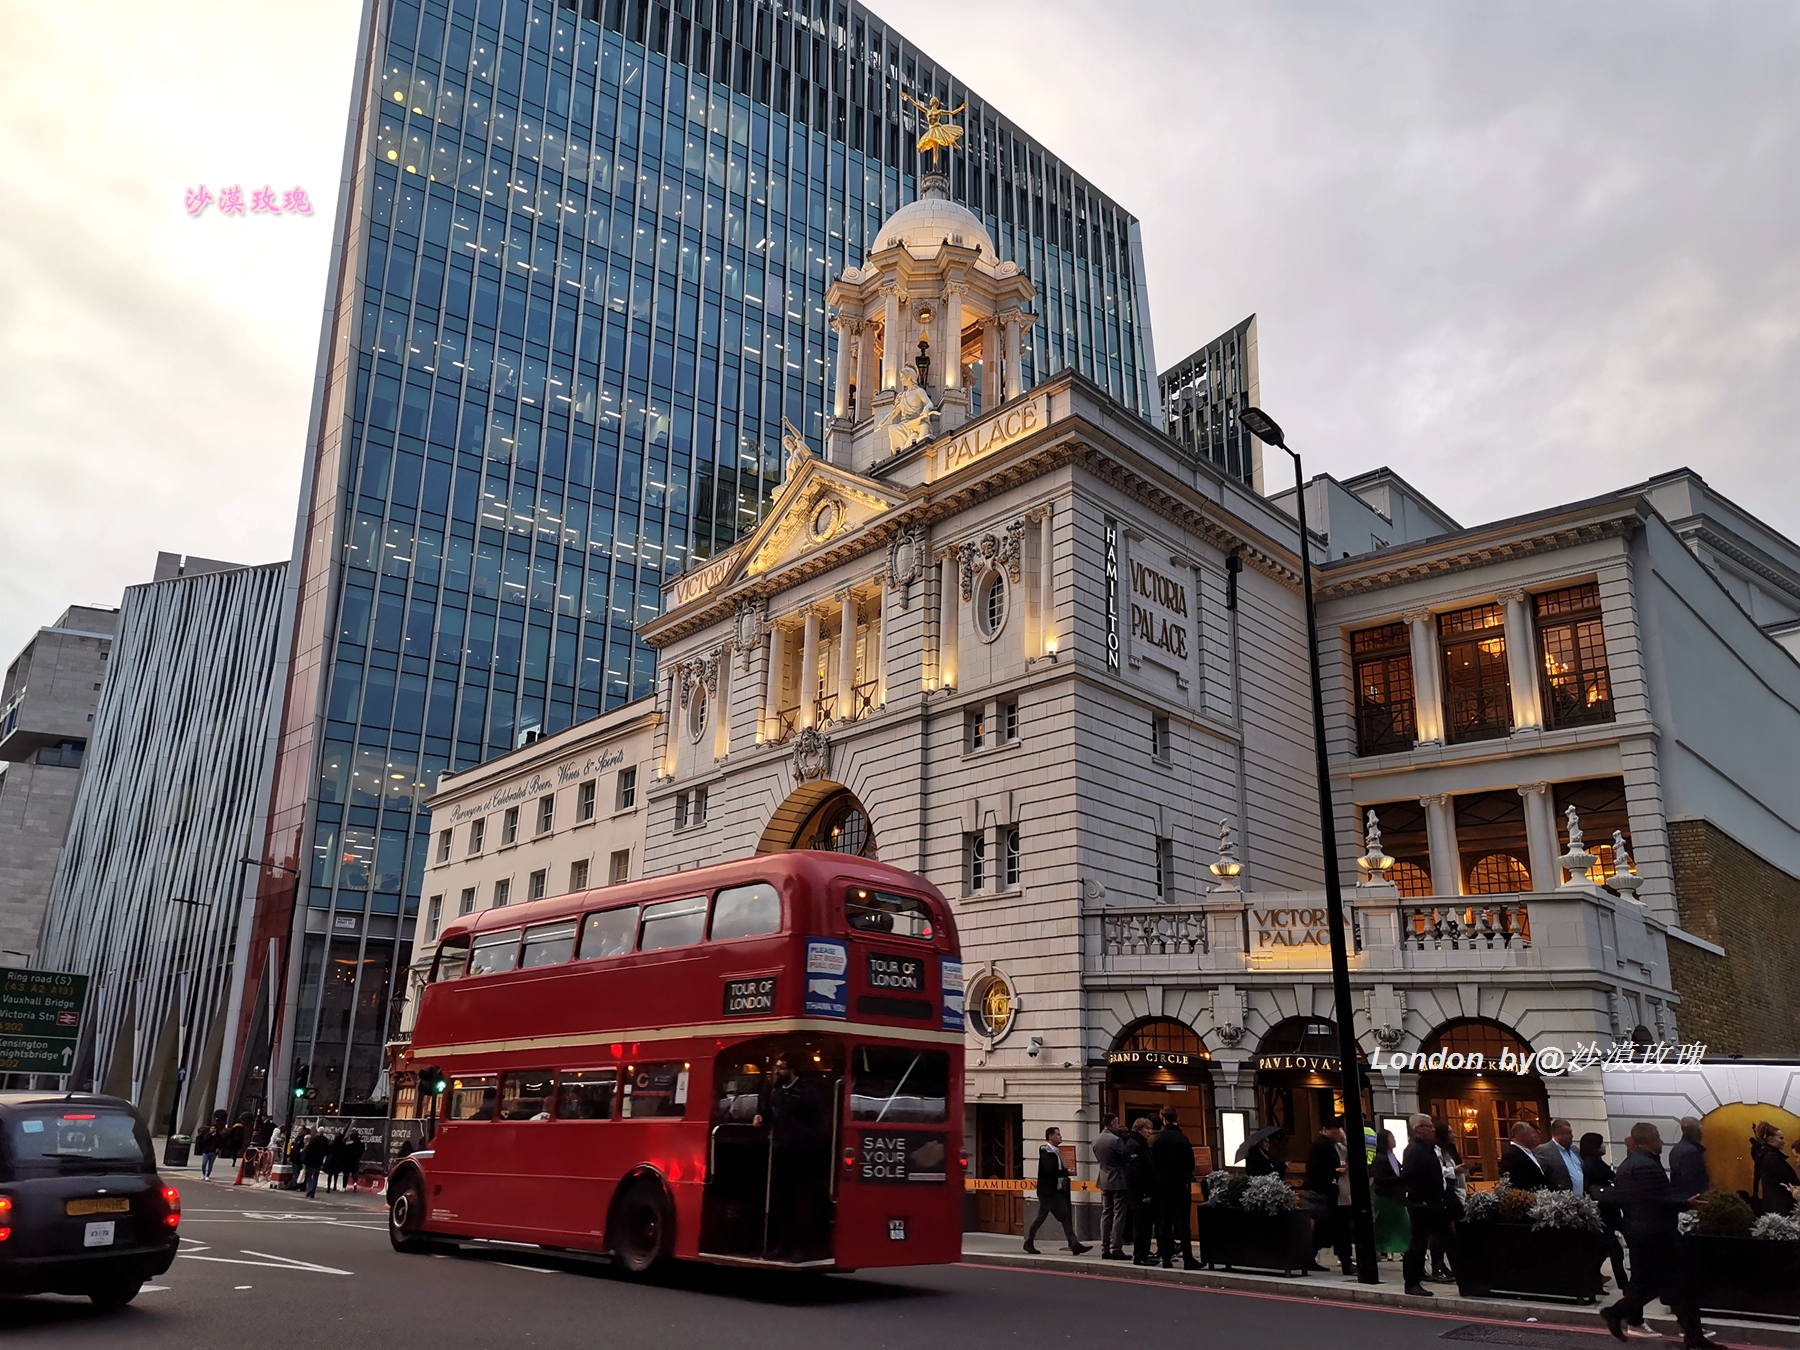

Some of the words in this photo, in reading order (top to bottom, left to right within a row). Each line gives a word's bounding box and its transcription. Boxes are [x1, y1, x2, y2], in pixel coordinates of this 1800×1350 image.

[944, 402, 1037, 471] PALACE
[676, 558, 734, 604] VICTORIA
[1129, 558, 1188, 618] VICTORIA
[1106, 526, 1119, 669] HAMILTON
[1131, 602, 1188, 660] PALACE
[492, 780, 530, 808] Celebrated
[557, 761, 580, 785] Wines
[583, 758, 595, 776] &
[595, 748, 624, 774] Spirits
[1258, 929, 1331, 947] PALAC
[810, 946, 836, 955] PLEASE
[809, 961, 827, 969] PULL
[828, 963, 842, 971] OUT
[870, 959, 898, 973] TOUR
[902, 962, 916, 975] OF
[7, 971, 28, 983] Ring
[31, 975, 53, 984] road
[55, 975, 72, 986] (S)
[871, 974, 917, 989] LONDON
[730, 982, 757, 996] TOUR
[758, 980, 773, 993] OF
[2, 994, 42, 1006] Vauxhall
[45, 997, 75, 1009] Bridge
[729, 996, 772, 1011] LONDON
[806, 1002, 831, 1011] THANK
[833, 1003, 846, 1013] YOU
[0, 1009, 36, 1021] Victoria
[38, 1012, 55, 1021] Stn
[0, 1048, 59, 1061] nightsbridge
[1109, 1053, 1140, 1064] GRAND
[1145, 1053, 1189, 1065] CIRCLE
[863, 1137, 906, 1150] SAVE
[863, 1151, 906, 1163] YOUR
[862, 1165, 906, 1178] SOLE
[973, 1180, 1037, 1190] HAMILTON
